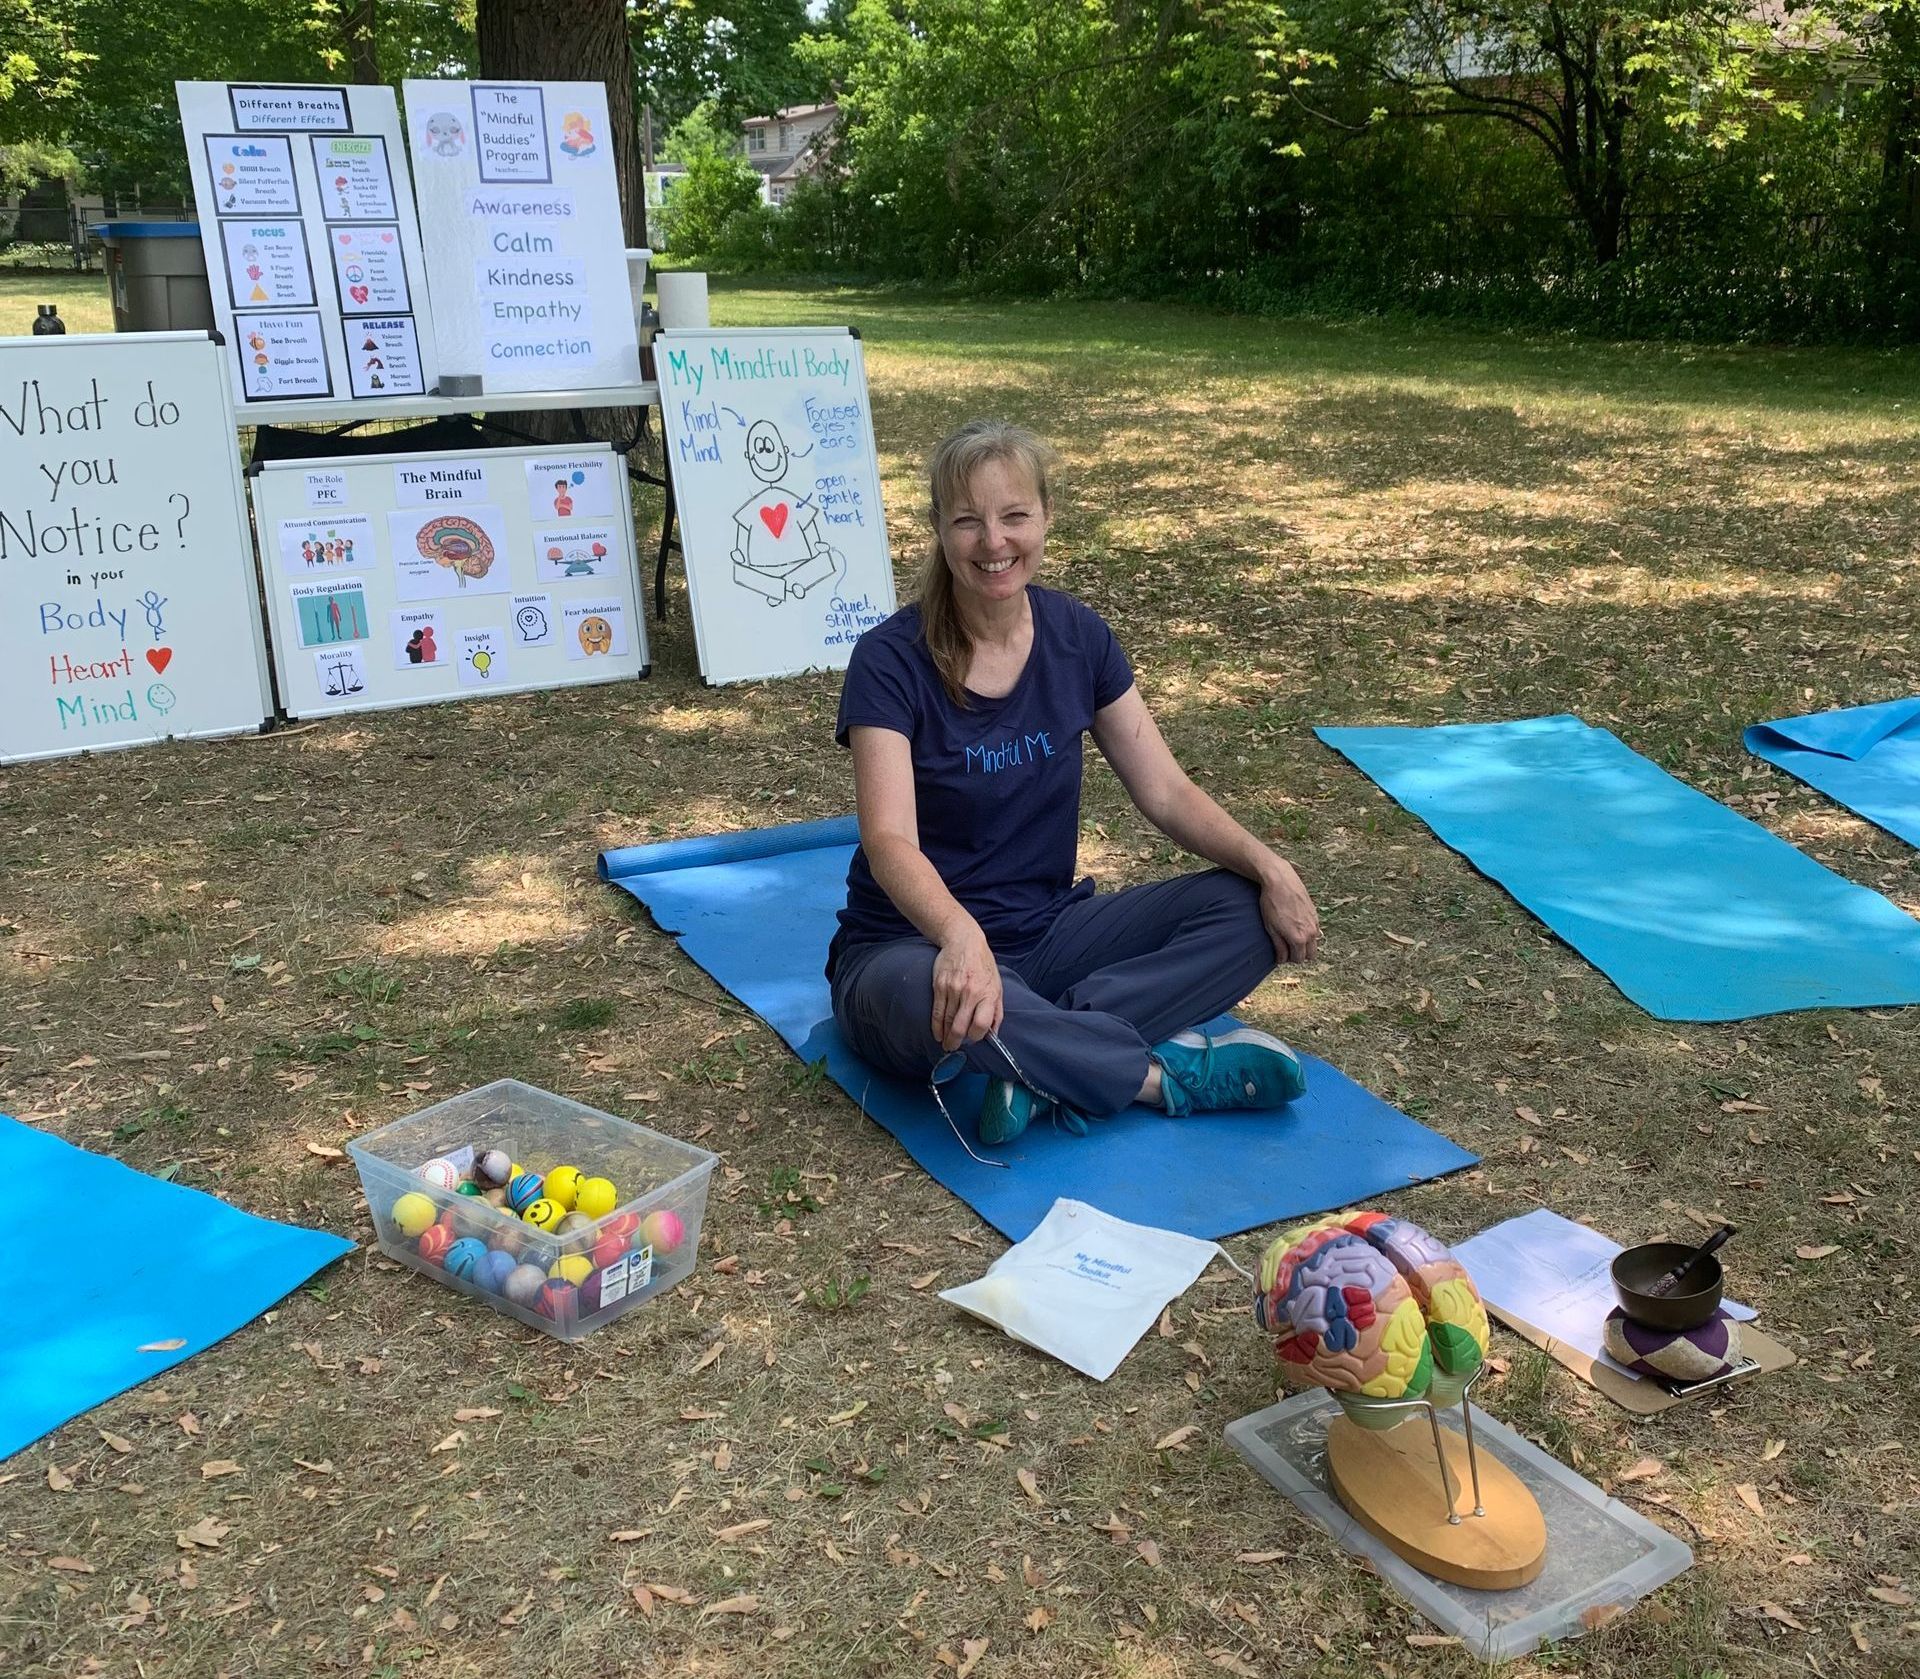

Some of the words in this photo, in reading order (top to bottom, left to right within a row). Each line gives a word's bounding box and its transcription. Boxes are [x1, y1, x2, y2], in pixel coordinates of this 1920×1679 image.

[239, 100, 292, 110] Different
[298, 100, 340, 110] Breaths
[495, 92, 518, 104] The
[252, 115, 297, 125] Different
[300, 115, 335, 125] Effects
[480, 111, 534, 125] “Mindful
[483, 134, 535, 145] Buddies”
[232, 145, 267, 157] Calm
[331, 141, 371, 154] ENERGIZE
[486, 150, 539, 164] Program
[472, 198, 571, 216] Awareness
[252, 228, 286, 237] FOCUS
[494, 232, 553, 253] Calm
[488, 268, 574, 286] Kindness
[493, 300, 582, 324] Empathy
[260, 320, 283, 329] Have
[286, 320, 303, 328] Fun
[362, 321, 405, 330] RELEASE
[490, 339, 592, 358] Connection
[274, 358, 295, 366] Giggle
[669, 350, 703, 395] My
[711, 347, 798, 380] Mindful
[804, 348, 849, 386] Body
[134, 380, 180, 428] do
[805, 397, 861, 423] Focused
[682, 400, 721, 432] Kind
[811, 422, 846, 438] eyes
[680, 433, 723, 464] Mind
[819, 435, 857, 449] ears
[534, 464, 568, 472] Response
[568, 461, 603, 469] Flexibility
[40, 458, 118, 502] you
[307, 476, 324, 484] The
[325, 475, 343, 483] Role
[400, 472, 427, 484] The
[430, 469, 482, 483] Mindful
[815, 475, 846, 492] open
[317, 490, 337, 499] PFC
[425, 488, 462, 500] Brain
[819, 491, 863, 509] gentle
[283, 521, 312, 529] Attuned
[313, 516, 367, 527] Communication
[824, 510, 864, 527] heart
[544, 535, 580, 543] Emotional
[66, 569, 81, 586] in
[90, 569, 125, 589] your
[292, 587, 315, 596] Body
[316, 582, 363, 594] Regulation
[514, 595, 546, 603] Intuition
[401, 613, 434, 622] Empathy
[564, 609, 581, 617] Fear
[582, 605, 621, 615] Modulation
[40, 599, 127, 641] Body
[825, 613, 853, 628] Still
[464, 634, 490, 642] Insight
[824, 631, 844, 646] and
[320, 650, 353, 661] Morality
[50, 648, 134, 684] Heart
[56, 690, 138, 730] Mind
[1025, 732, 1056, 762] ME
[1074, 1252, 1091, 1263] My
[1092, 1258, 1132, 1274] Mindful
